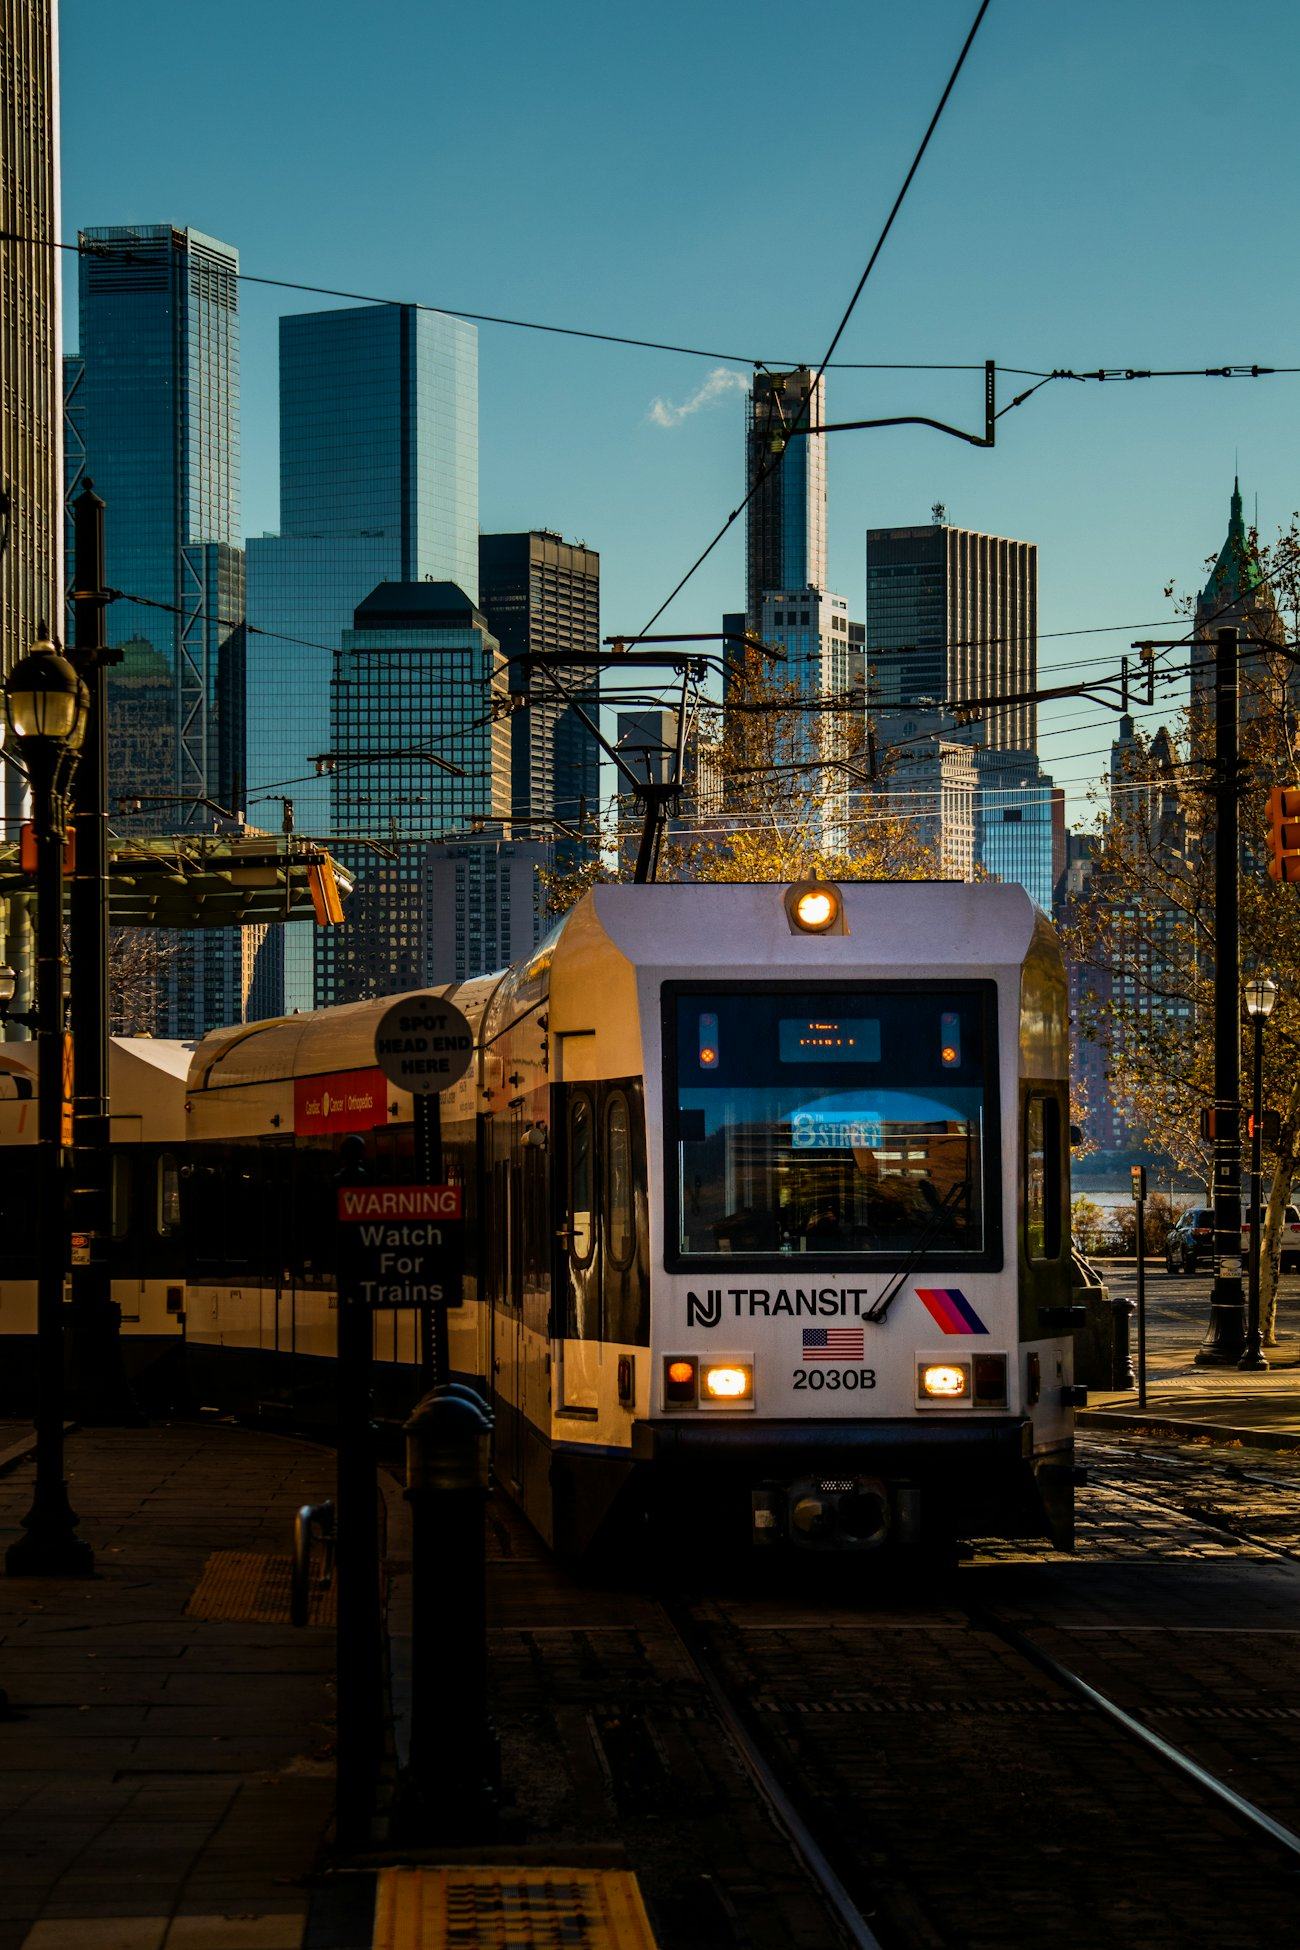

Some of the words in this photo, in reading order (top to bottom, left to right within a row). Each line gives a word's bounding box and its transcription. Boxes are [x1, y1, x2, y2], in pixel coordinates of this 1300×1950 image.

[399, 1015, 447, 1031] SPOT
[379, 1039, 427, 1053] HEAD
[433, 1036, 470, 1051] END
[402, 1059, 450, 1074] HERE
[330, 1097, 344, 1113] Cancer
[347, 1092, 373, 1113] Orthopedics
[819, 1122, 878, 1147] STREET
[343, 1191, 457, 1215] WARNING
[359, 1223, 443, 1247] Watch
[380, 1252, 424, 1275] For
[360, 1280, 444, 1302] Trains
[687, 1289, 722, 1328] NJ
[728, 1289, 867, 1316] TRANSIT
[792, 1369, 876, 1390] 2030B
